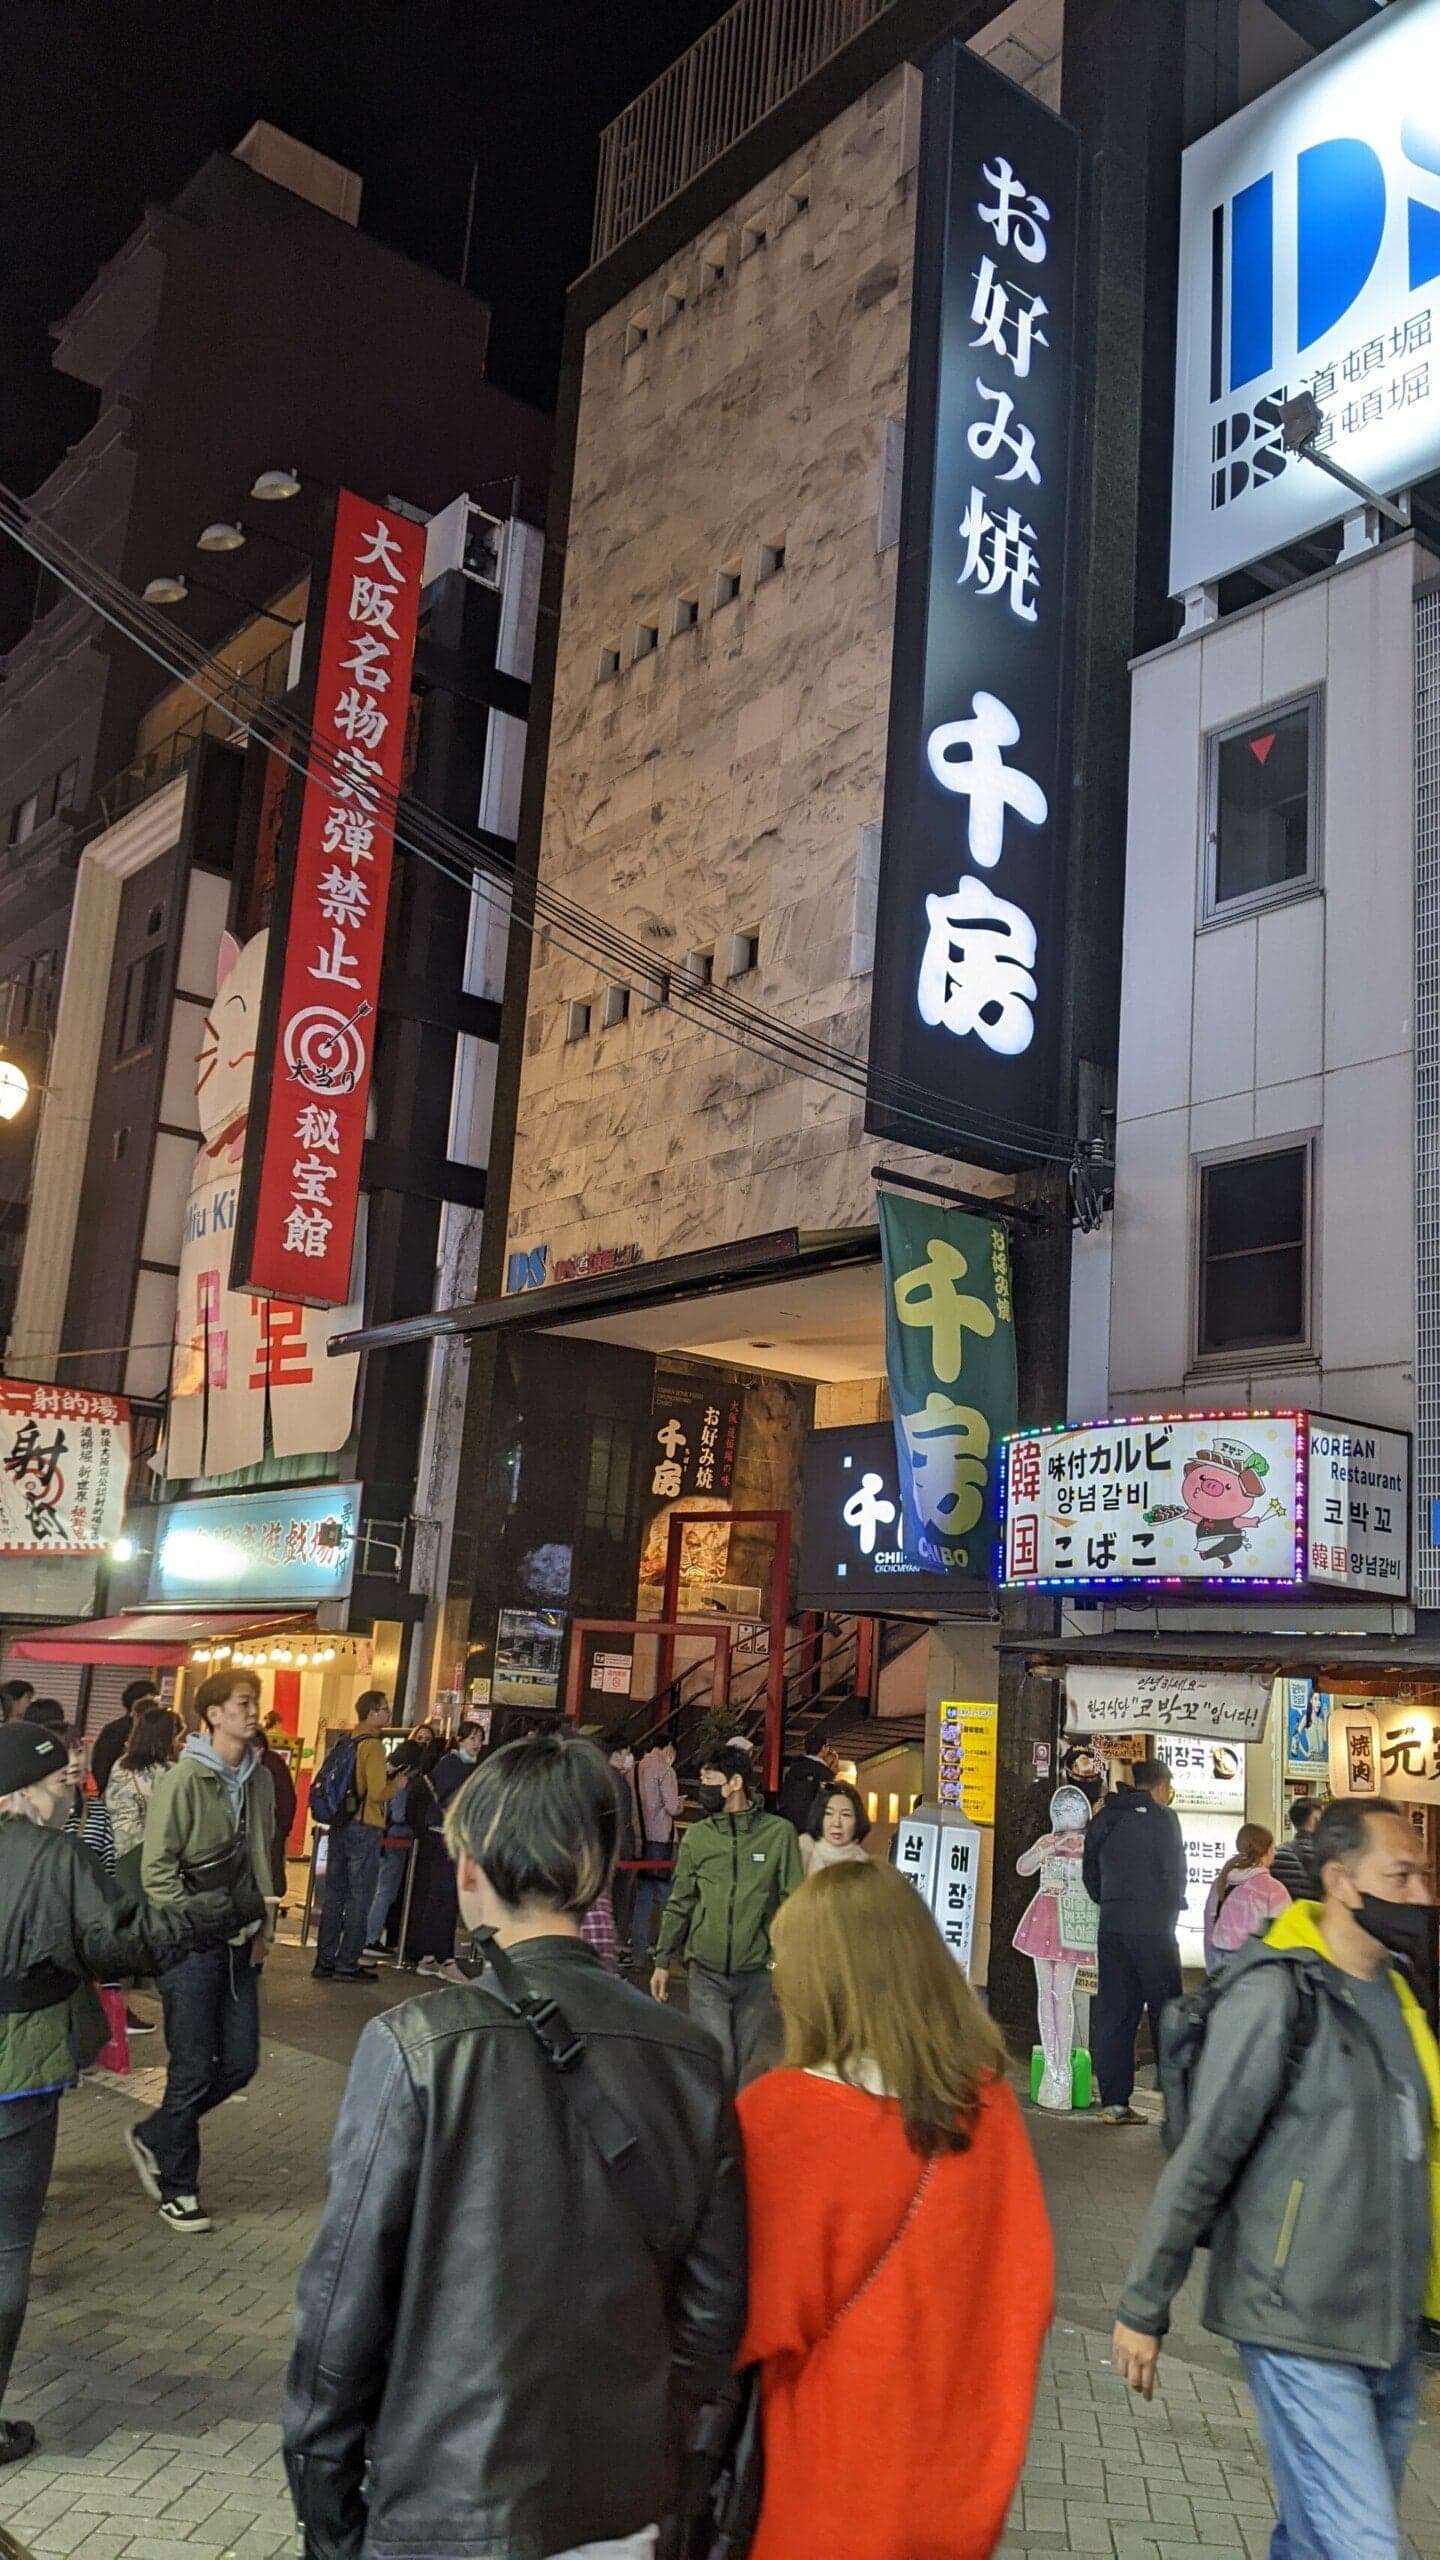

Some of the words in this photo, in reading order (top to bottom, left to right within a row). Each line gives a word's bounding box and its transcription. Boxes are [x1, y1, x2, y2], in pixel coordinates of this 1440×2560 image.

[957, 156, 1051, 623] お好み焼
[304, 519, 406, 990] 大阪名物実弾禁止
[918, 691, 1048, 1056] 千房
[287, 1058, 355, 1092] 大当り
[282, 1102, 341, 1258] 秘宝館
[0, 1387, 118, 1420] 一射的場
[895, 1239, 995, 1536] 千房
[652, 1419, 687, 1498] 千房
[696, 1406, 720, 1489] お好み焼
[1048, 1425, 1173, 1482] 味付カルビ
[1311, 1436, 1375, 1459] KOREAN
[1057, 1480, 1149, 1515] 양념갈비
[1331, 1461, 1402, 1493] Restaurant
[844, 1473, 903, 1553] 千
[1007, 1440, 1042, 1579] 韓国
[1323, 1498, 1393, 1534] 코박꼬
[918, 1536, 969, 1568] CHIBO
[1054, 1531, 1157, 1571] こばこ
[1312, 1542, 1348, 1573] 韓国
[1350, 1553, 1401, 1580] 양념갈비
[1158, 1745, 1205, 1769] 해장국
[945, 1845, 970, 1948] 해장국
